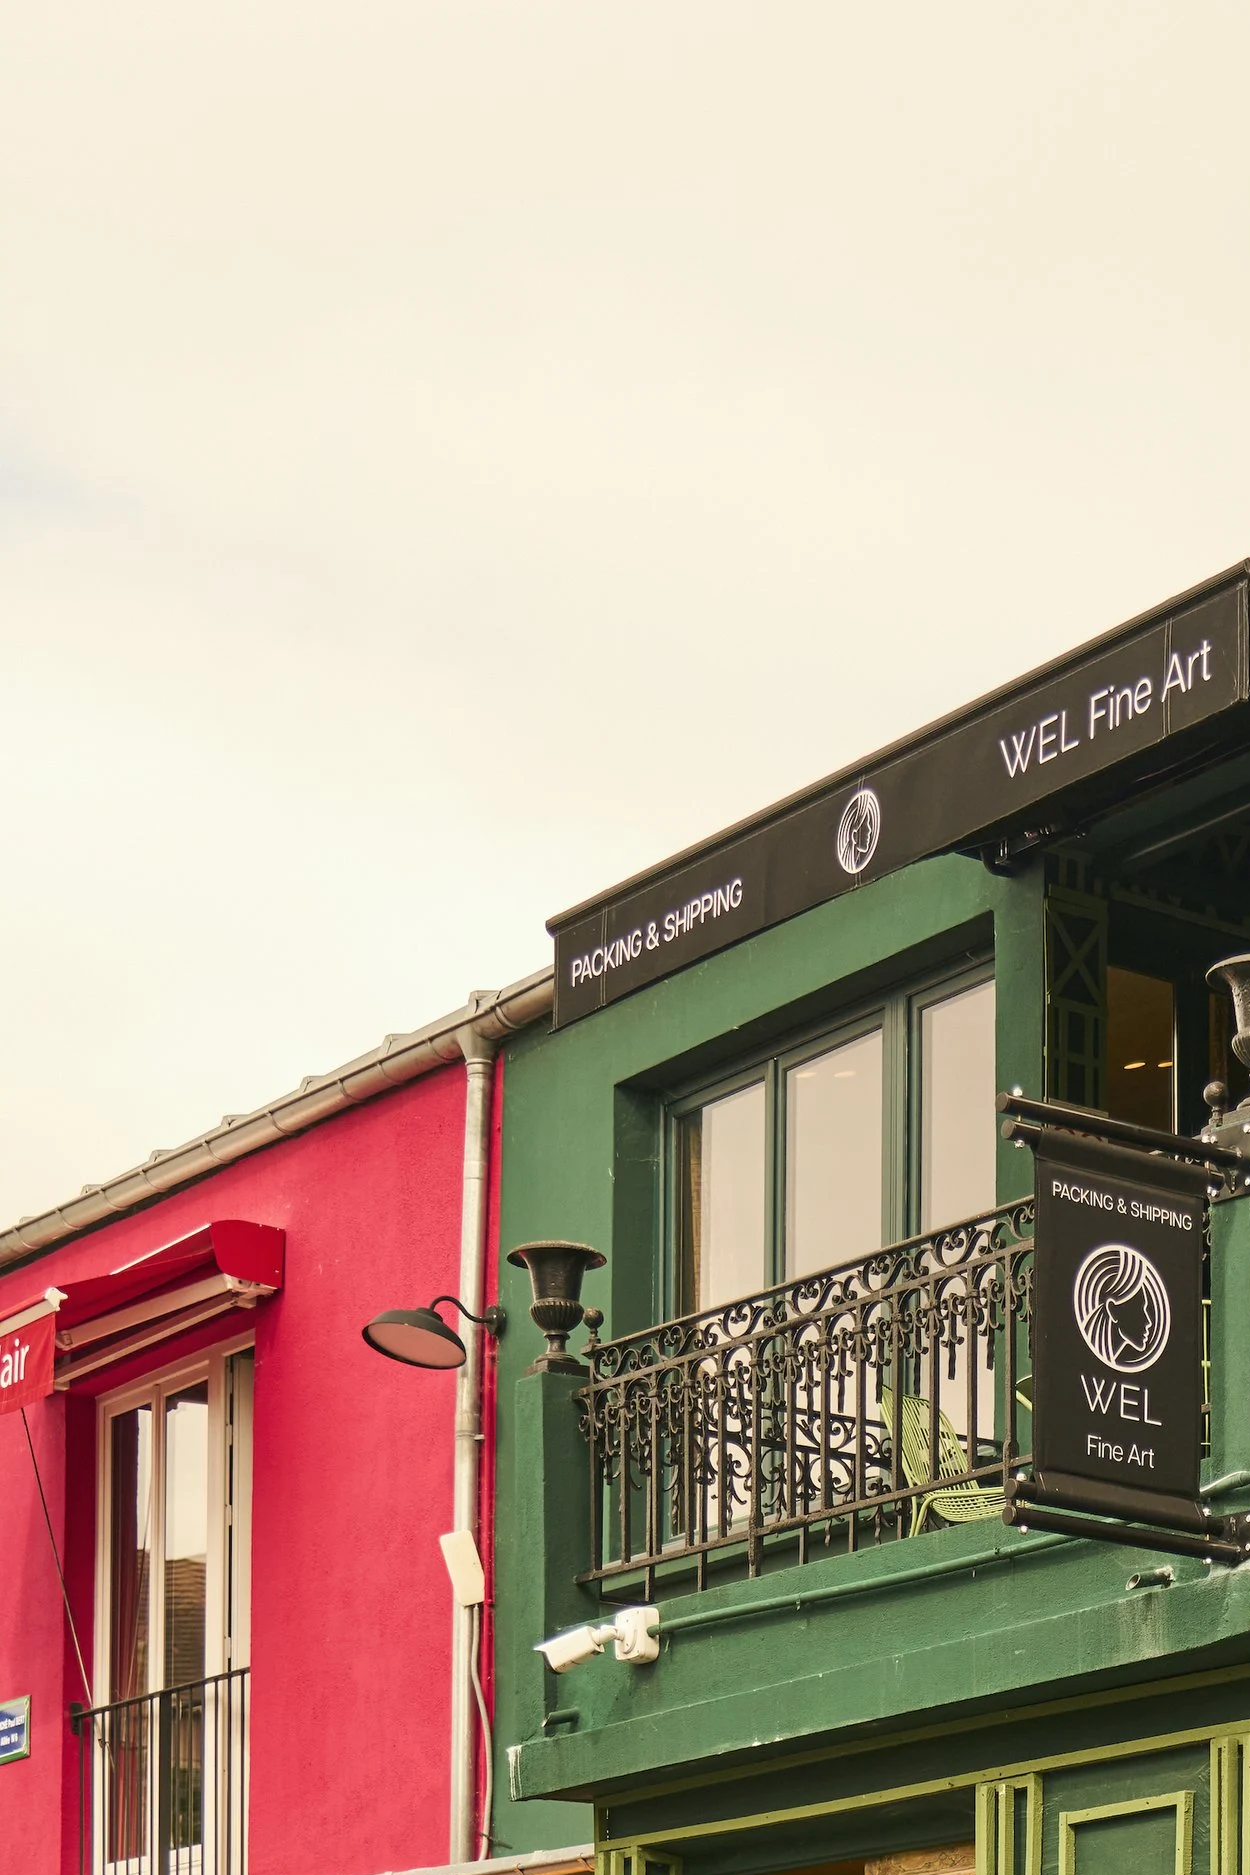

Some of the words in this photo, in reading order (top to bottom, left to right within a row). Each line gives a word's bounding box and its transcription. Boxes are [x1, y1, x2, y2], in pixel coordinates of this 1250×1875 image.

[1000, 709, 1080, 778] WEL
[1089, 677, 1152, 740] Fine
[1161, 639, 1212, 703] Art
[571, 929, 643, 988] PACKING
[645, 922, 660, 951] &
[663, 878, 743, 943] SHIPPING
[1052, 1181, 1114, 1211] PACKING
[1116, 1198, 1127, 1215] &
[1130, 1201, 1193, 1231] SHIPPING
[1080, 1374, 1163, 1427] WEL
[1087, 1434, 1124, 1462] Fine
[1127, 1444, 1155, 1469] Art
